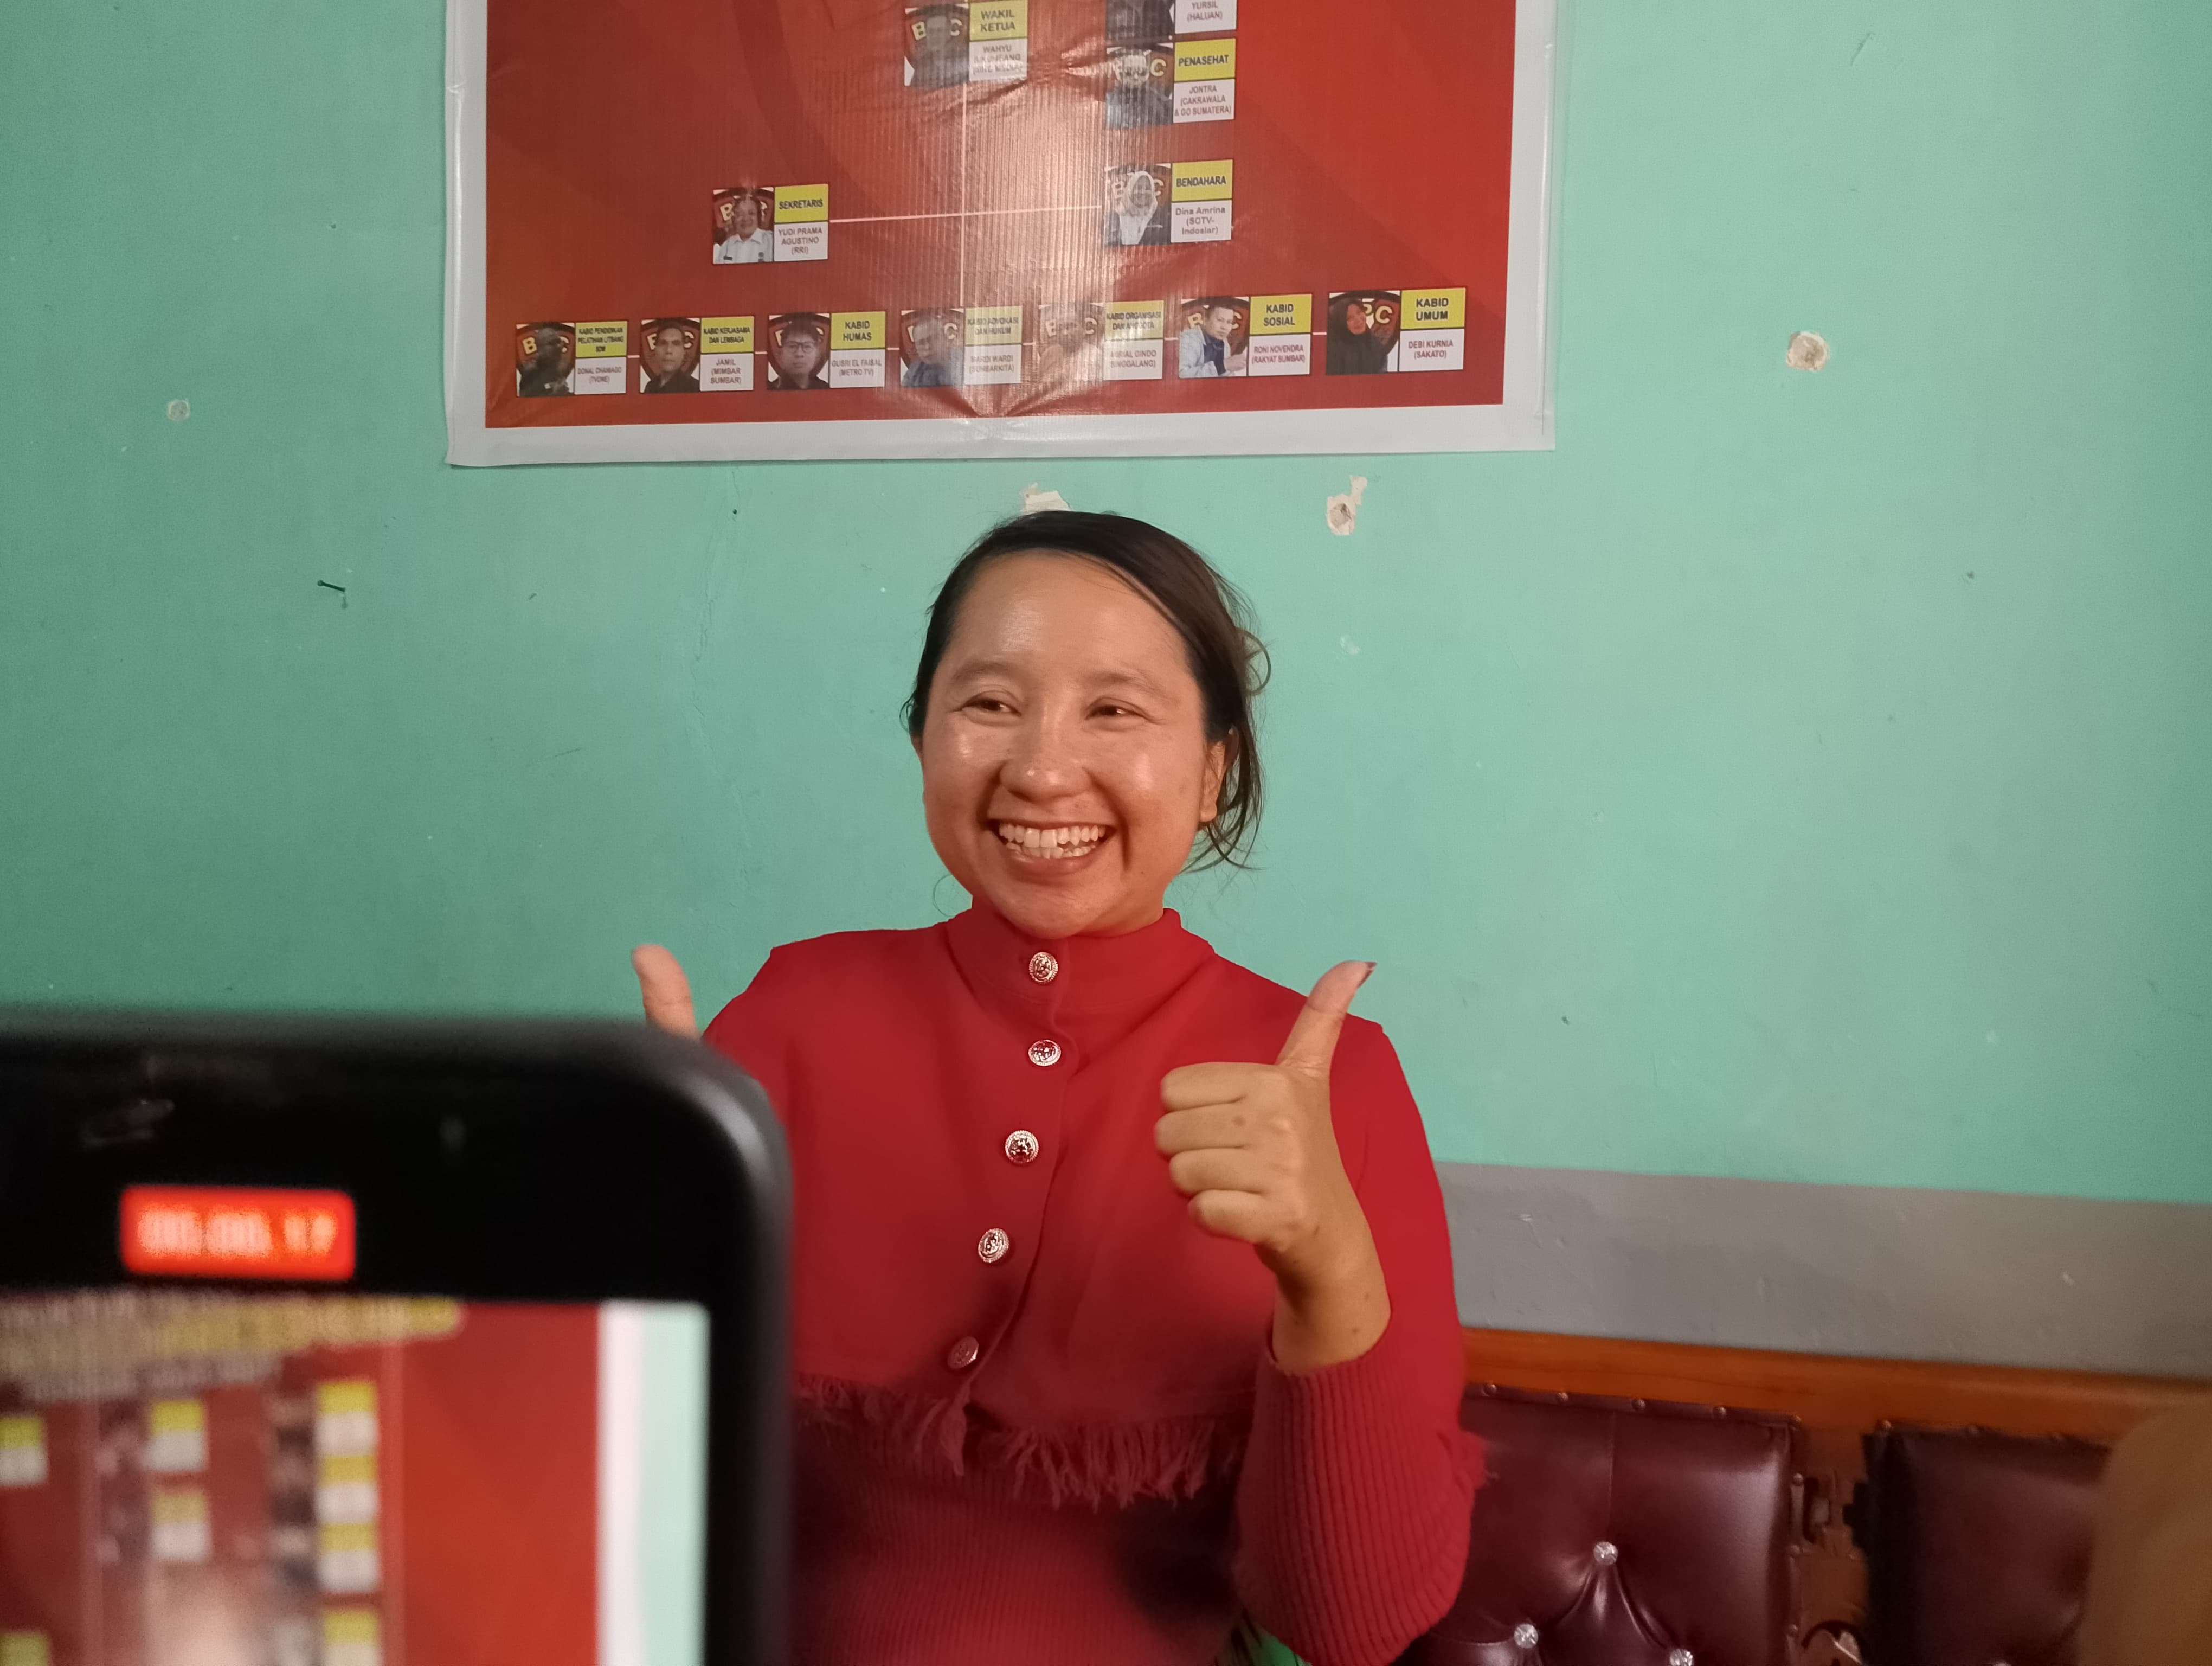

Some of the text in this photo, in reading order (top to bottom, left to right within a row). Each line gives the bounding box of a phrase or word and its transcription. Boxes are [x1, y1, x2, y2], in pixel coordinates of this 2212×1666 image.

[981, 9, 1015, 20] WAKIL
[1187, 11, 1223, 22] (HALUAN)
[980, 21, 1015, 32] KETUA
[983, 44, 1012, 53] WAHYU
[1178, 55, 1229, 67] PENASEHAT
[1189, 85, 1217, 94] JONTRA
[1180, 95, 1226, 106] (CAKRAWALA
[1181, 108, 1192, 116] GO
[1193, 105, 1231, 116] SUMATERA)
[1176, 176, 1226, 187] BENDAHARA
[779, 199, 823, 209] SEKRETARIS
[1175, 206, 1225, 216] Dina Amrina
[779, 228, 795, 236] YUDI
[781, 236, 819, 245] AGUSTINO
[792, 247, 808, 255] (RRI)
[1416, 298, 1449, 308] KABID
[1266, 304, 1294, 313] KABID
[1416, 311, 1448, 321] UMUM
[845, 321, 870, 329] KABID
[1263, 317, 1295, 326] SOSIAL
[843, 332, 872, 341] HUMAS
[1254, 344, 1303, 354] RONI NOVENDRA
[1409, 339, 1453, 349] DEBI KURNIA
[1252, 356, 1277, 364] (RAKYAT
[1414, 351, 1447, 360] (SAKATO)
[839, 368, 874, 377] (METRO TV)
